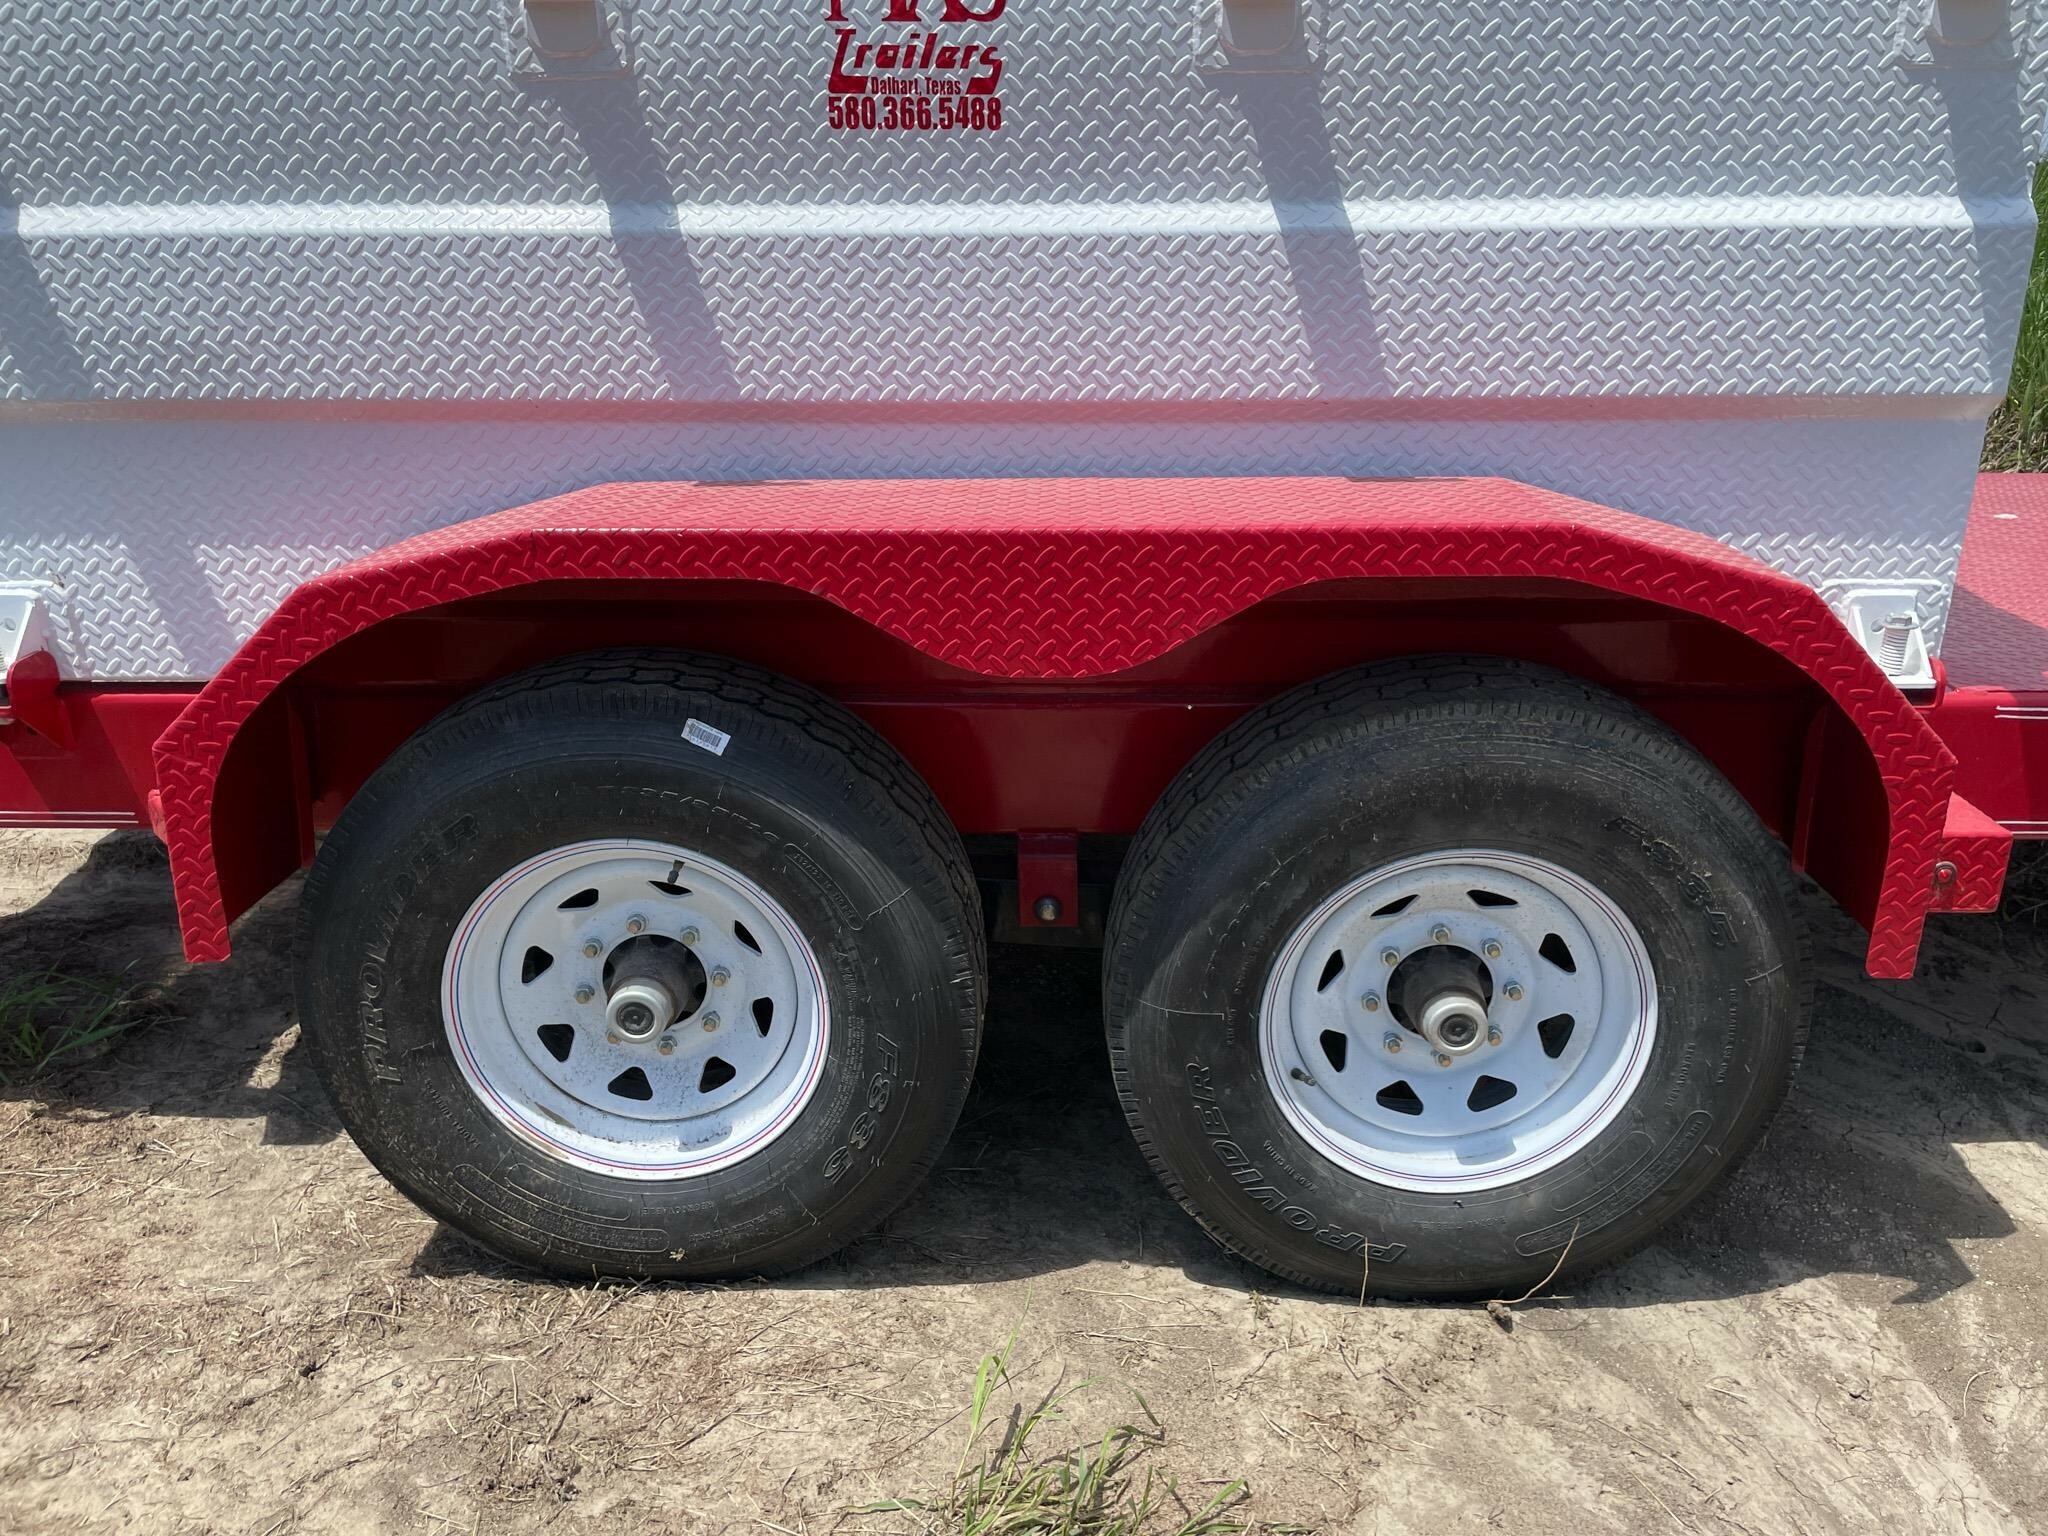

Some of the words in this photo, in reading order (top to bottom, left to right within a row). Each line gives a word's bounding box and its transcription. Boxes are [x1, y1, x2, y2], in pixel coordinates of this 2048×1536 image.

[828, 29, 1003, 95] Trailers
[871, 77, 922, 96] Dalhart,
[925, 78, 961, 95] Texas
[828, 97, 1002, 130] 580.366.5488
[1186, 1063, 1408, 1262] PROVIDER
